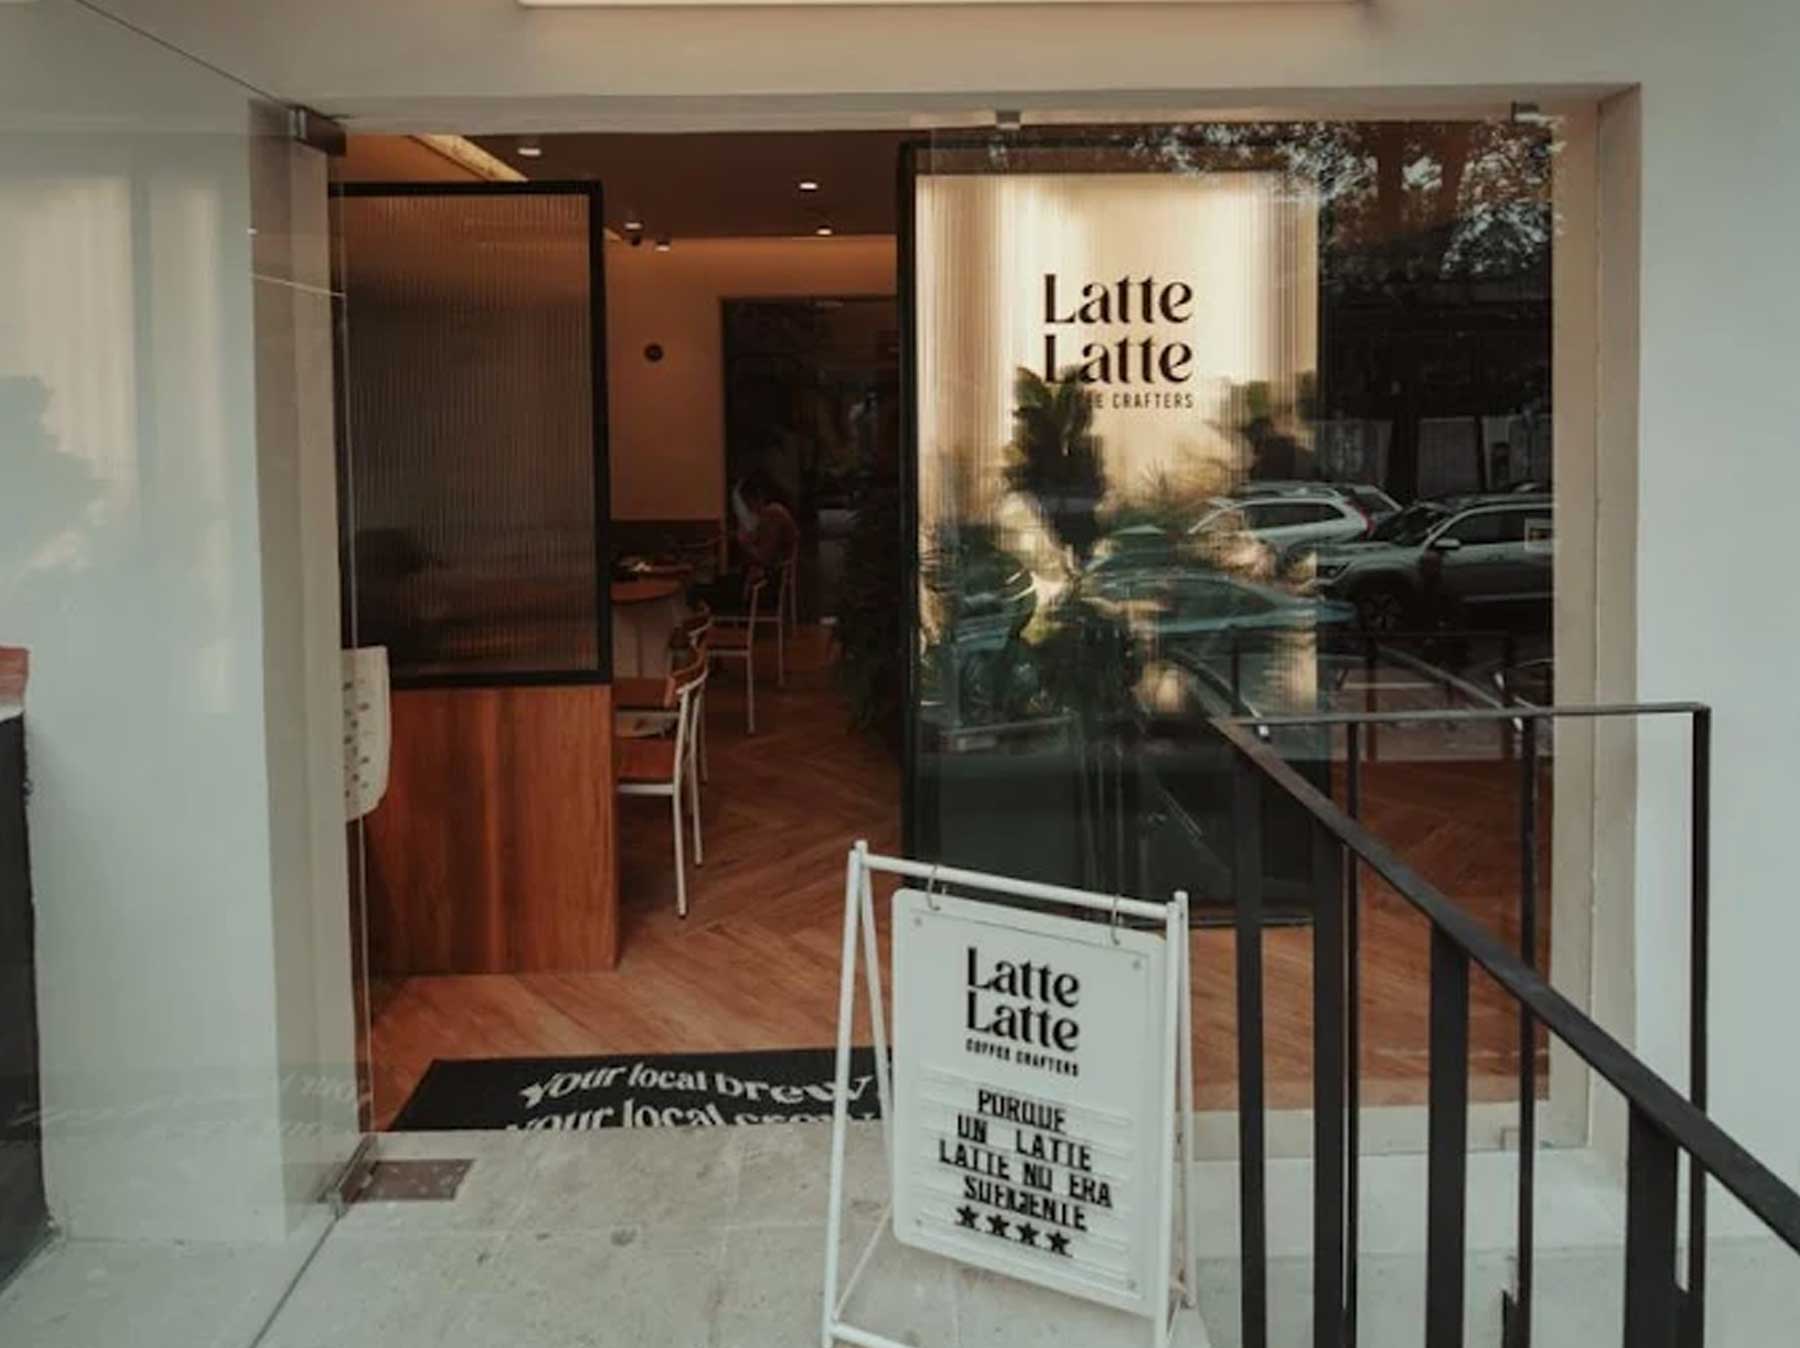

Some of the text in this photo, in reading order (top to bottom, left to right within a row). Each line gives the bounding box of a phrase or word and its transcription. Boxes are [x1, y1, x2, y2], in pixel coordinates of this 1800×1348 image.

[1044, 273, 1193, 324] Latte
[1044, 333, 1193, 384] Latte
[1112, 392, 1194, 409] CRAFTERS
[966, 946, 1080, 1008] Latte
[966, 990, 1080, 1052] Latte
[519, 1062, 873, 1109] your local brew
[1015, 1050, 1080, 1077] CRAFTERS
[977, 1088, 1067, 1135] PORQUE
[956, 1113, 1092, 1172] UN LATTE
[938, 1139, 1010, 1181] LATTE
[1069, 1173, 1113, 1209] ERA
